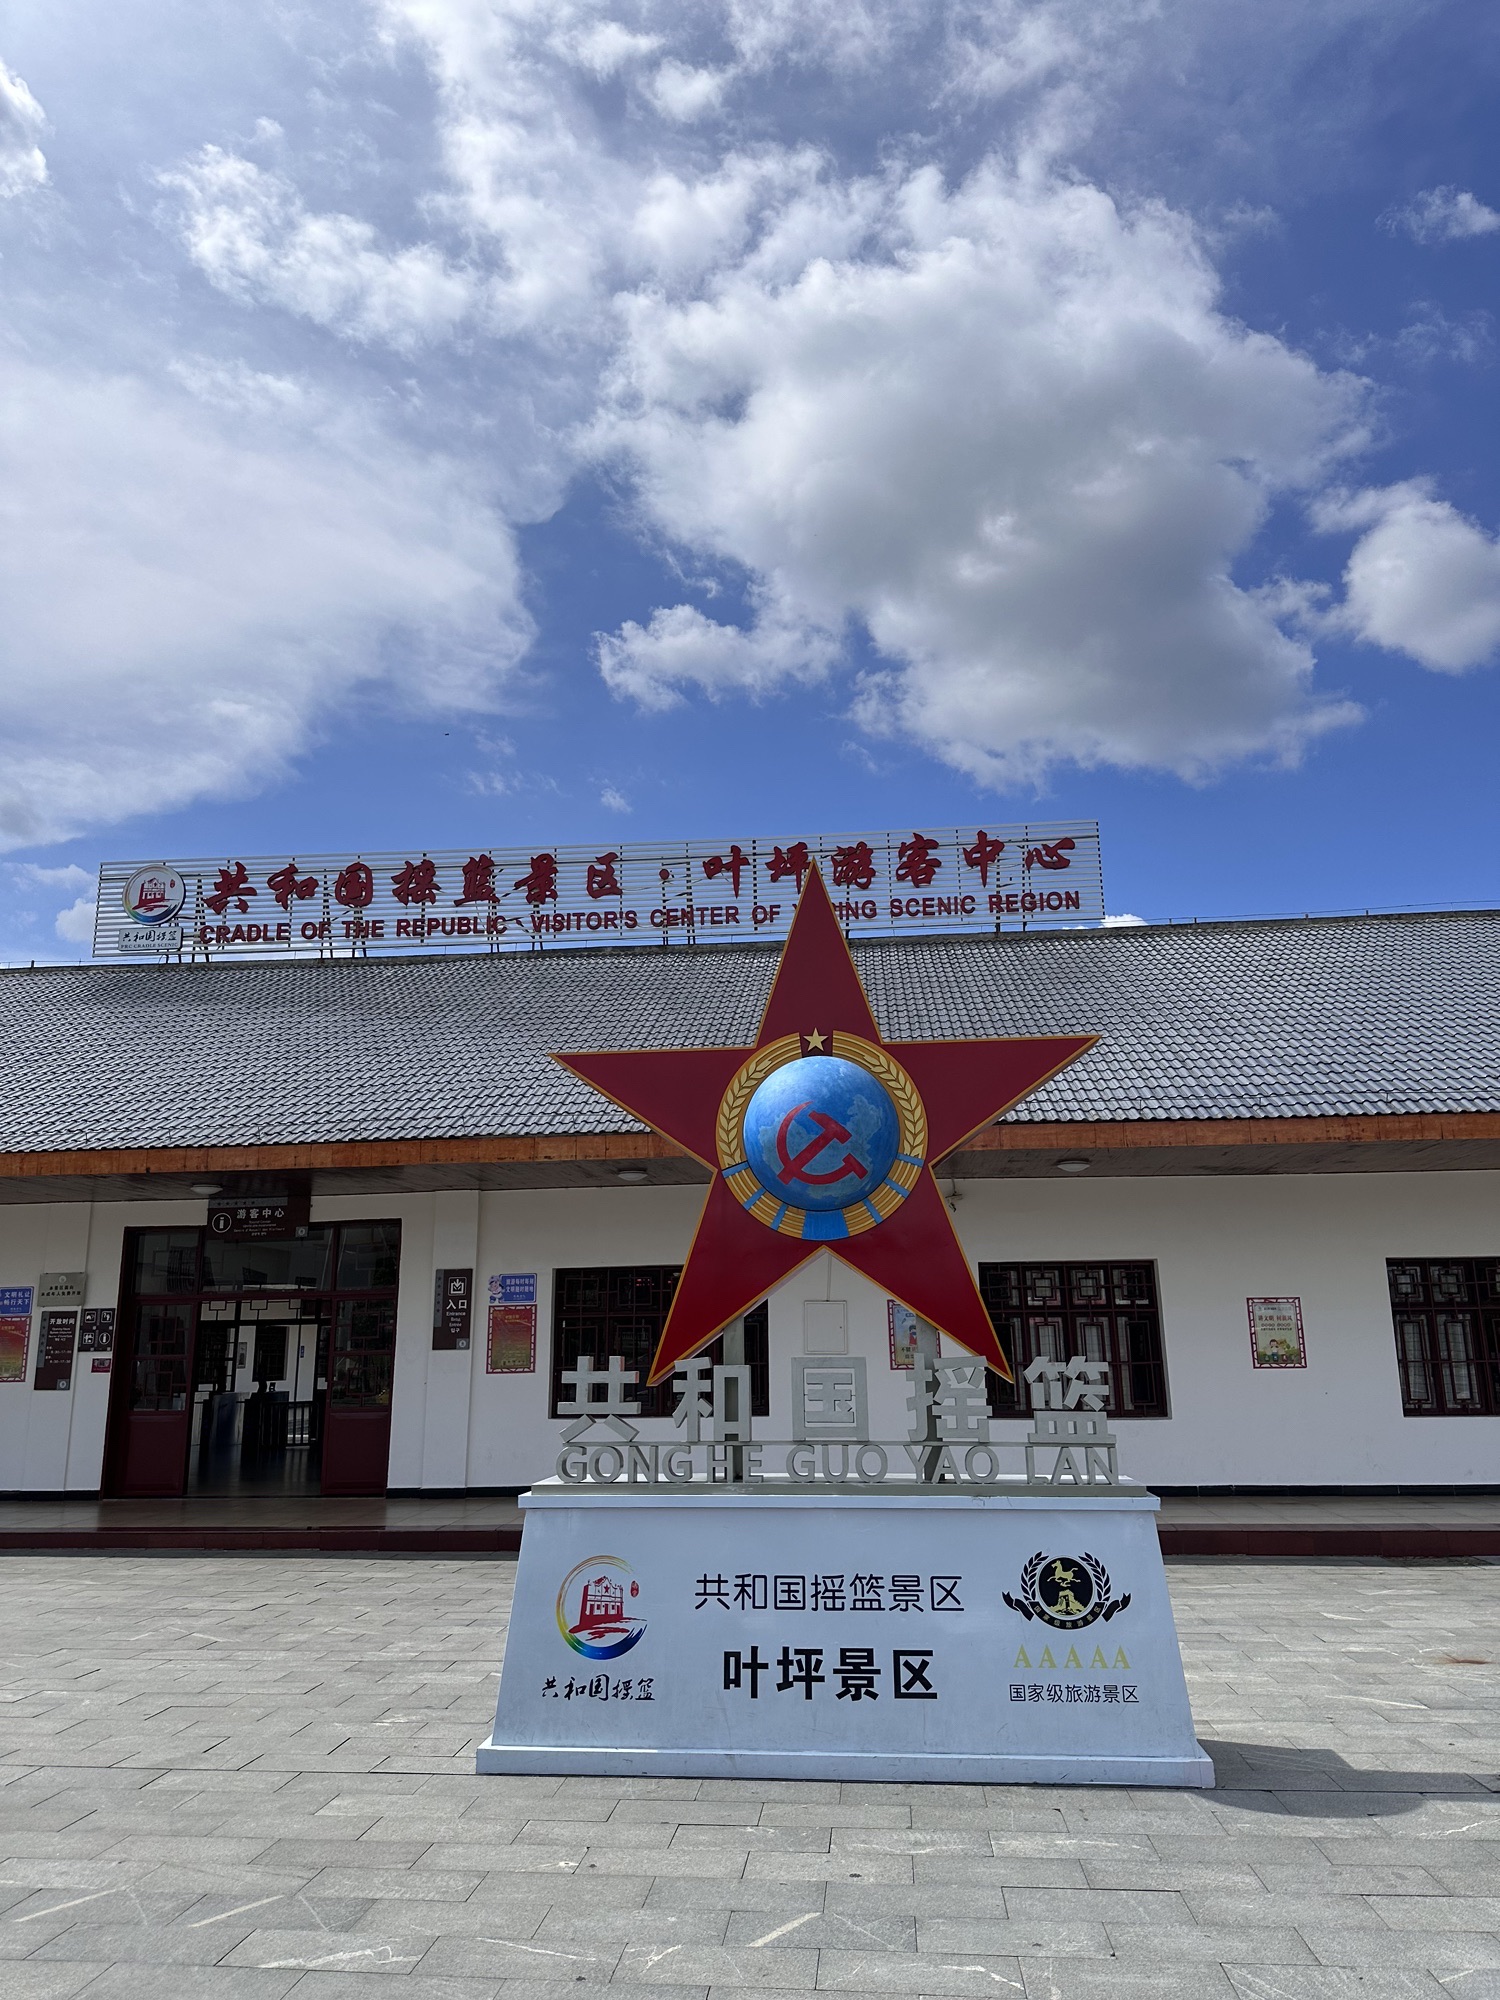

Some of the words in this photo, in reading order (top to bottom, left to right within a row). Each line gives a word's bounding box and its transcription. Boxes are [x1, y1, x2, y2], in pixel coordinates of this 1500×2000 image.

[200, 922, 291, 944] CRADLE
[301, 920, 332, 940] OF
[341, 919, 385, 939] THE
[396, 915, 508, 937] REPUBLIC
[530, 910, 638, 932] VISITOR'S
[650, 905, 739, 927] CENTER
[752, 904, 781, 924] OF
[792, 899, 877, 921] ING
[890, 895, 976, 917] SCENIC
[988, 890, 1080, 913] REGION
[237, 1207, 285, 1219] 游客中心
[446, 1299, 467, 1309] 入口
[557, 1353, 1116, 1443] 共和国摇篮
[555, 1445, 693, 1483] GONG
[706, 1445, 764, 1483] HE
[786, 1445, 888, 1483] GUO
[903, 1445, 1000, 1484] YAO
[1025, 1446, 1119, 1484] LAN
[694, 1573, 965, 1613] 共和国摇篮景区
[541, 1673, 656, 1702] 共和国摇篮
[723, 1645, 938, 1701] 叶坪景区
[1009, 1683, 1139, 1704] 国家级旅游景区
